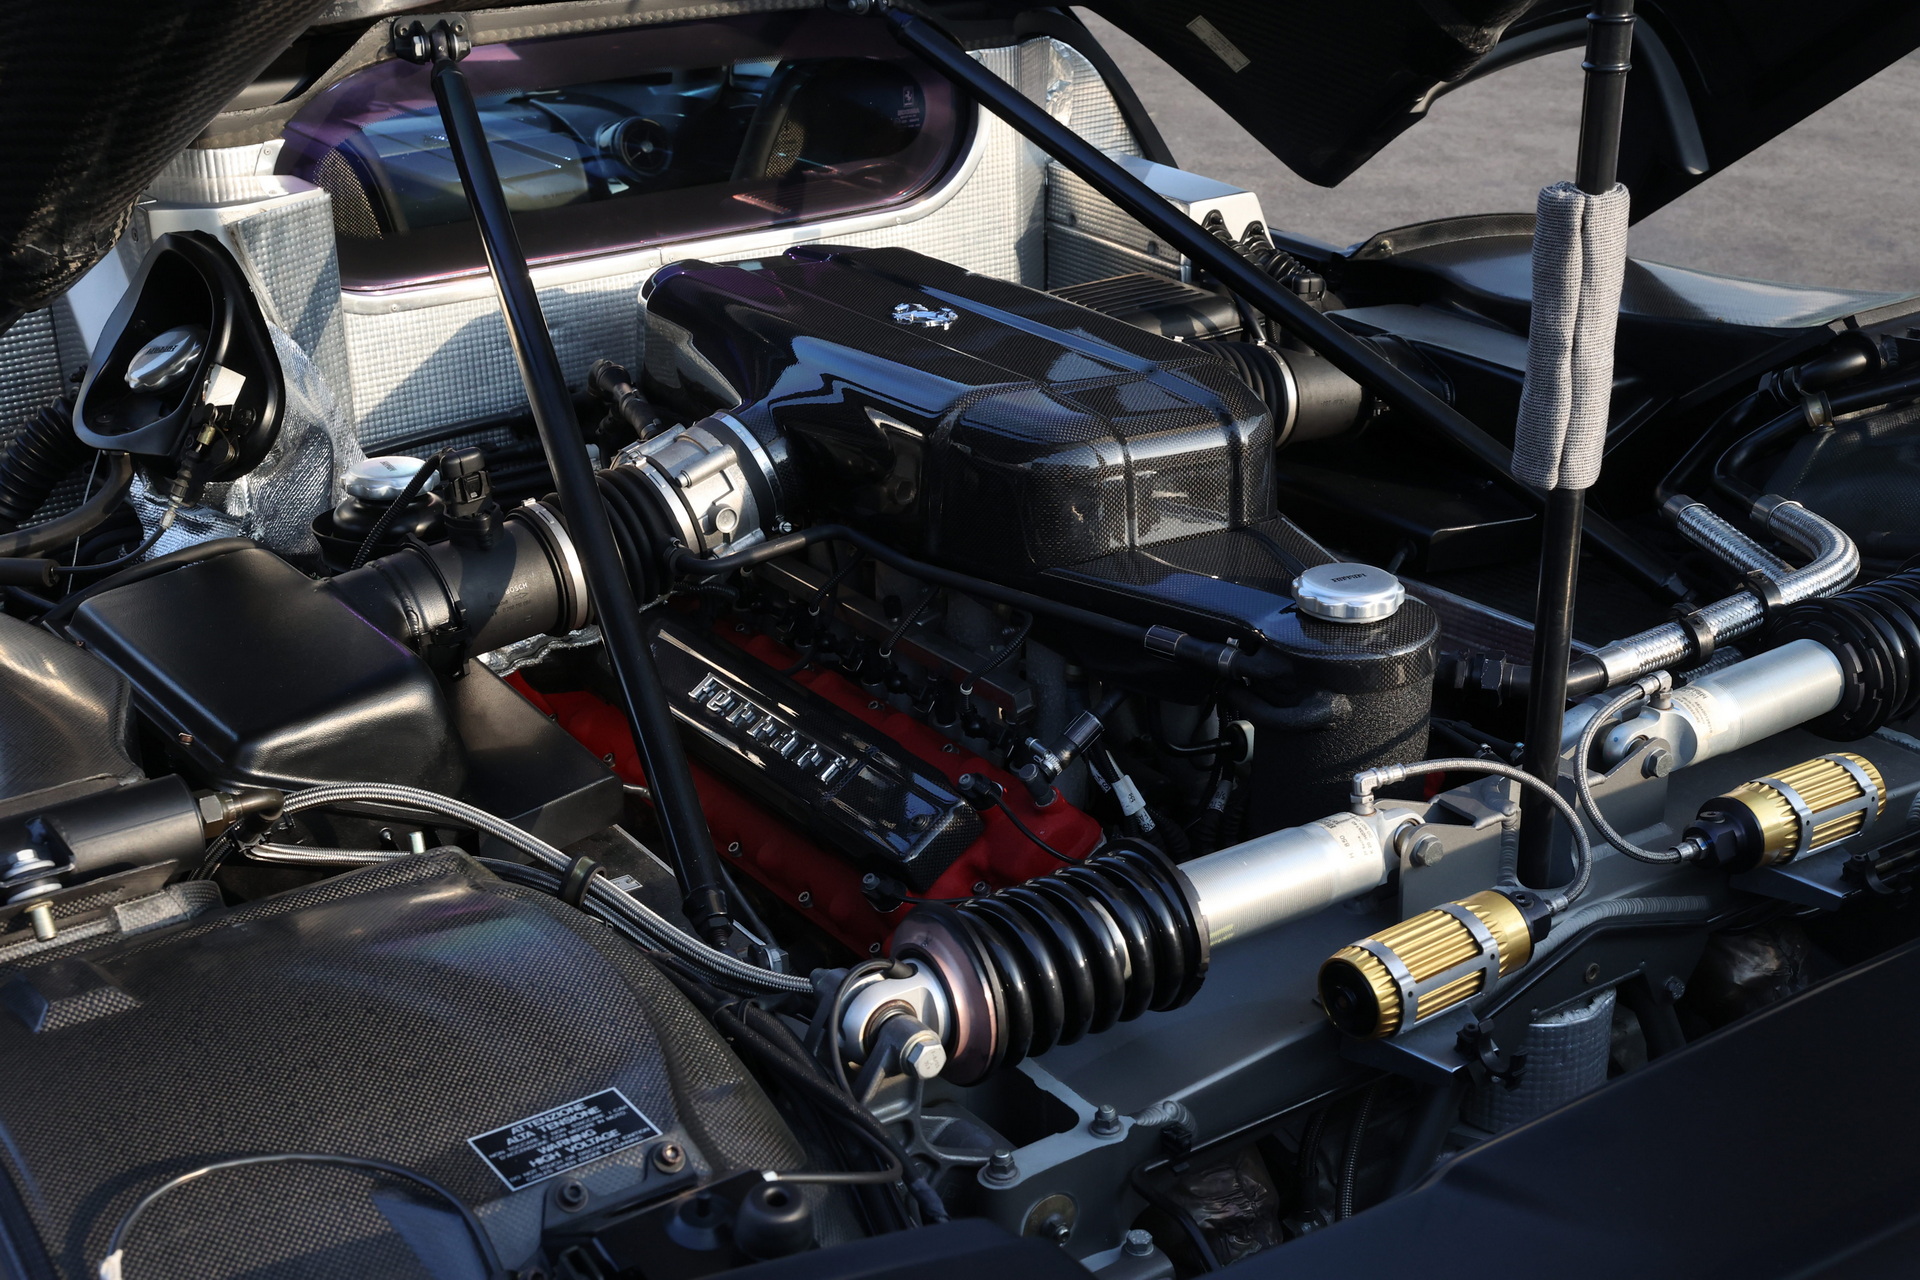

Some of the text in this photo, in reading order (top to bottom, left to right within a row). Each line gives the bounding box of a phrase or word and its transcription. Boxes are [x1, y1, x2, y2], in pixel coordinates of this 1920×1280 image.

[687, 671, 848, 784] Ferrari
[506, 1106, 601, 1146] ALTA TENSIONE
[511, 1102, 586, 1135] ATTENZIONE
[528, 1129, 621, 1167] HIGH VOLTAGE
[537, 1129, 597, 1154] WARNING
